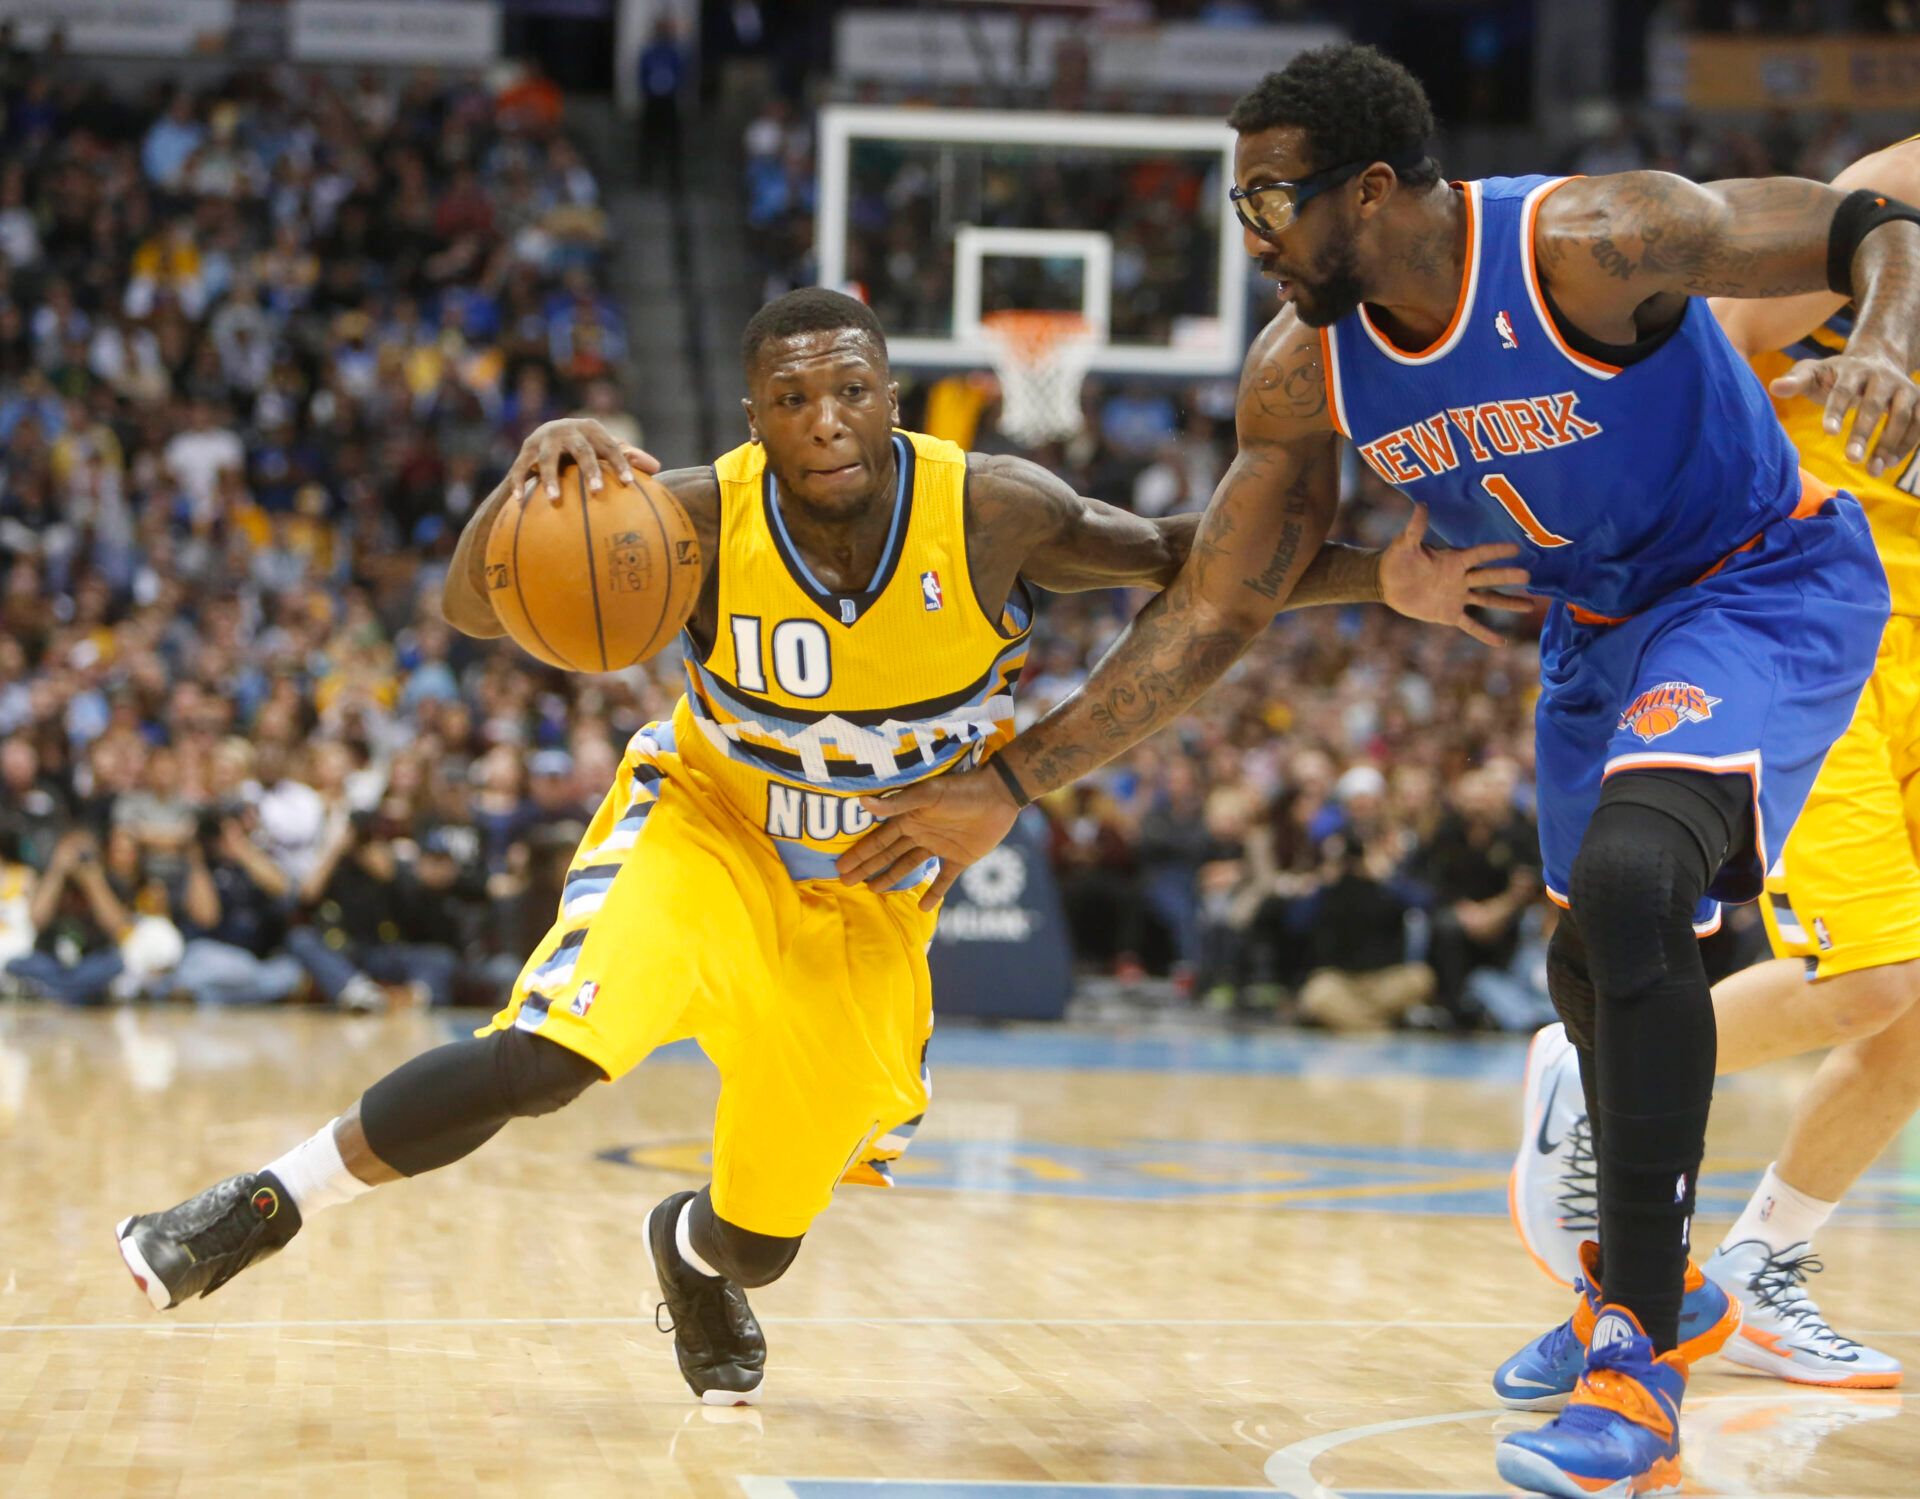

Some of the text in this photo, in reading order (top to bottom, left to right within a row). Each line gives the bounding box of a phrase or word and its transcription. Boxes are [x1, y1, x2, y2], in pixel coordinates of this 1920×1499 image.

[1446, 390, 1603, 462] YORK
[1481, 474, 1574, 548] 1
[839, 599, 856, 624] D
[730, 613, 833, 699] 10
[765, 780, 890, 841] NUG
